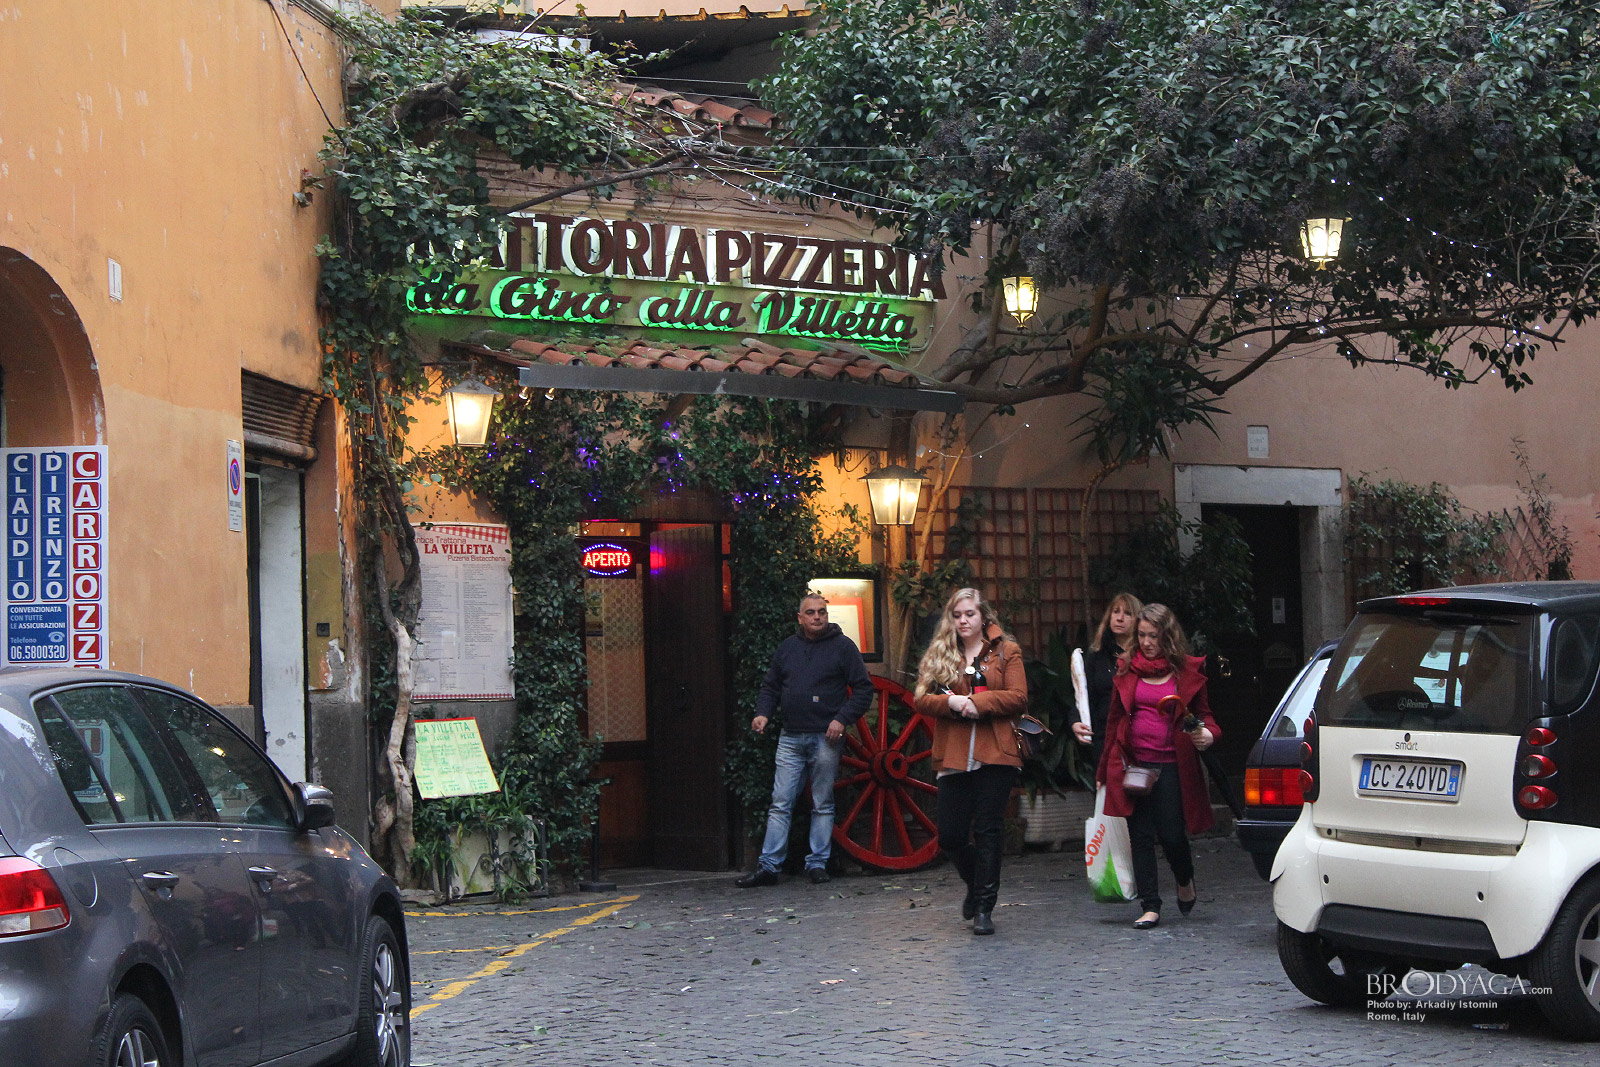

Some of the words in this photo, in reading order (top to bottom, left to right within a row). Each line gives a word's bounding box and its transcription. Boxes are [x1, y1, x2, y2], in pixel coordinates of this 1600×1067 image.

[408, 211, 709, 284] TTORIA
[715, 228, 947, 300] PIZZERIA
[493, 276, 632, 321] Gino
[643, 288, 746, 331] alla
[754, 291, 918, 342] Villetta
[12, 454, 30, 600] CLAUDIO
[46, 454, 63, 600] DIRENZO
[424, 543, 439, 554] LA
[441, 543, 495, 555] VILLETTA
[75, 453, 98, 668] CARROZZ
[583, 552, 631, 568] APERTO
[11, 645, 65, 659] 06.5800320
[1395, 741, 1418, 751] smart
[1371, 764, 1392, 787] CC
[1395, 765, 1448, 792] 240VD
